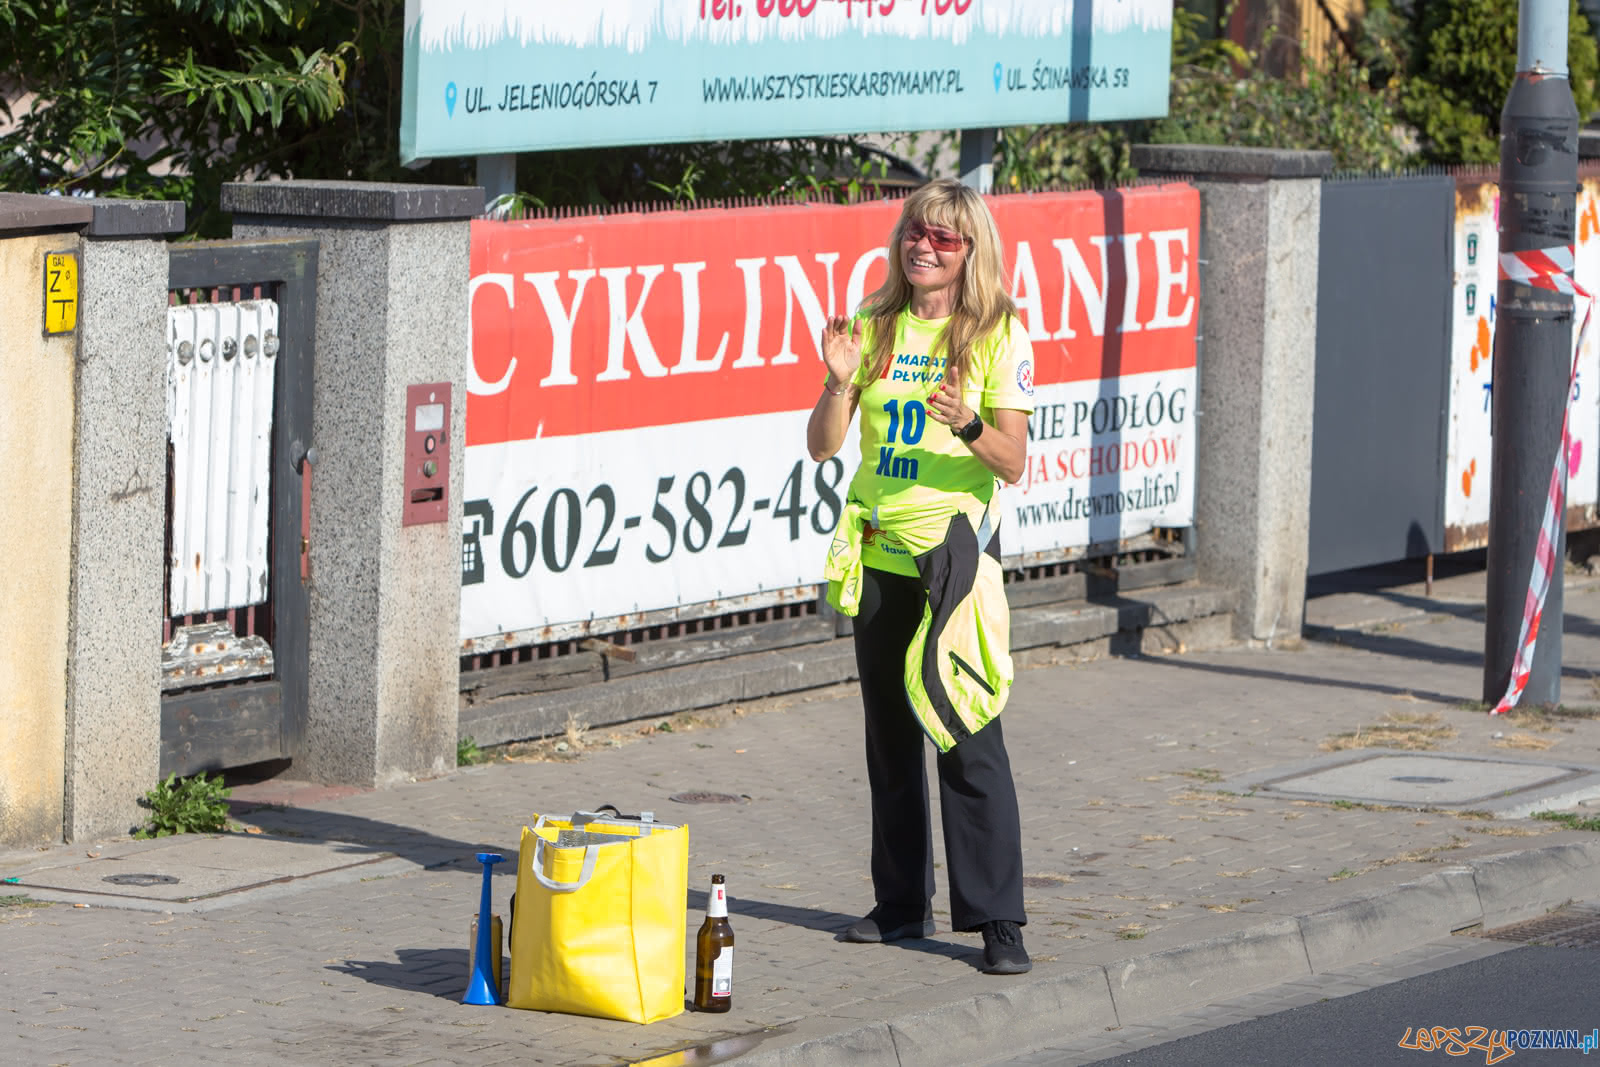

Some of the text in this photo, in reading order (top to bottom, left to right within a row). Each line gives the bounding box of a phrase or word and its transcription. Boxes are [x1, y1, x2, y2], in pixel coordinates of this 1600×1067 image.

[465, 72, 658, 113] UL. JELENIOGÓRSKA 7
[702, 69, 964, 103] WWW.WSZYSTKIESKARBYMAMY.PL
[1031, 58, 1109, 91] ŚCINAWSKA
[1112, 67, 1130, 89] 58
[52, 256, 66, 268] GAZ
[49, 270, 62, 293] Z
[896, 353, 949, 369] MARAT
[883, 399, 926, 445] 10
[1072, 381, 1187, 438] PODŁÓG
[1055, 430, 1182, 481] SCHODÓW
[500, 455, 845, 579] 602-582-48
